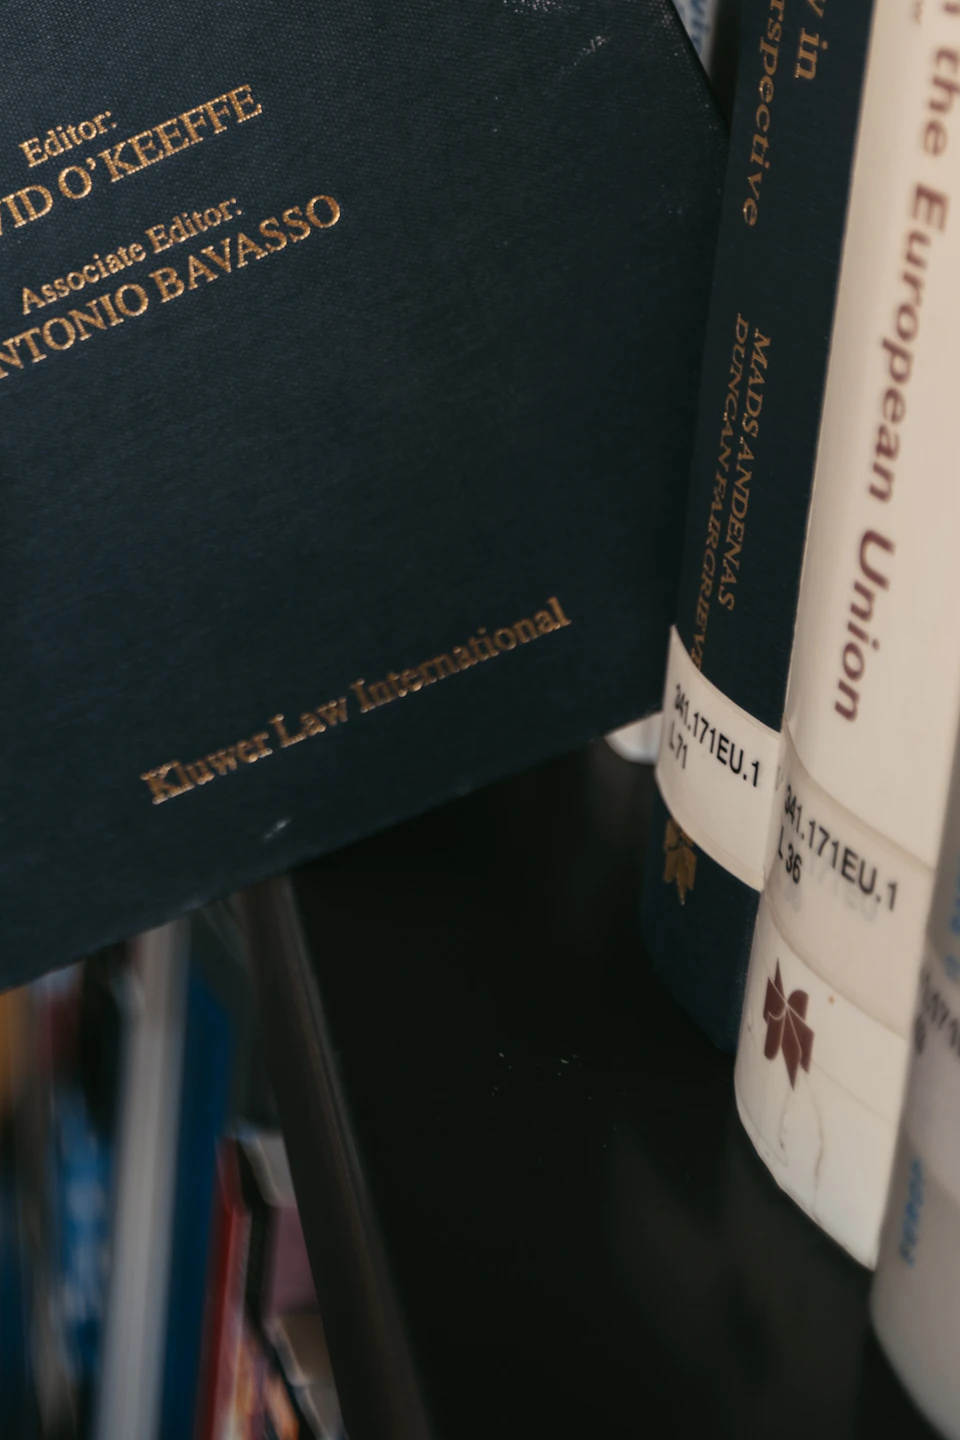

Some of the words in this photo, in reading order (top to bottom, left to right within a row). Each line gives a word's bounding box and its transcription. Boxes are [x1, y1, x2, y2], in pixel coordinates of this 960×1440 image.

[794, 29, 828, 79] in
[18, 110, 117, 169] Editor:
[57, 84, 263, 200] O’KEEFFE
[22, 242, 147, 315] Associate
[146, 197, 243, 254] Editor:
[148, 195, 341, 303] BAVASSO
[718, 313, 749, 470] DUNCAN
[742, 328, 771, 437] MADS
[868, 181, 950, 504] European
[718, 437, 754, 610] ANDENAS
[835, 529, 897, 723] Union
[140, 731, 274, 806] Kluwer
[269, 696, 349, 748] Law
[350, 596, 571, 715] International
[674, 683, 761, 788] 341.171EU.1
[784, 784, 899, 912] 341.171EU.1
